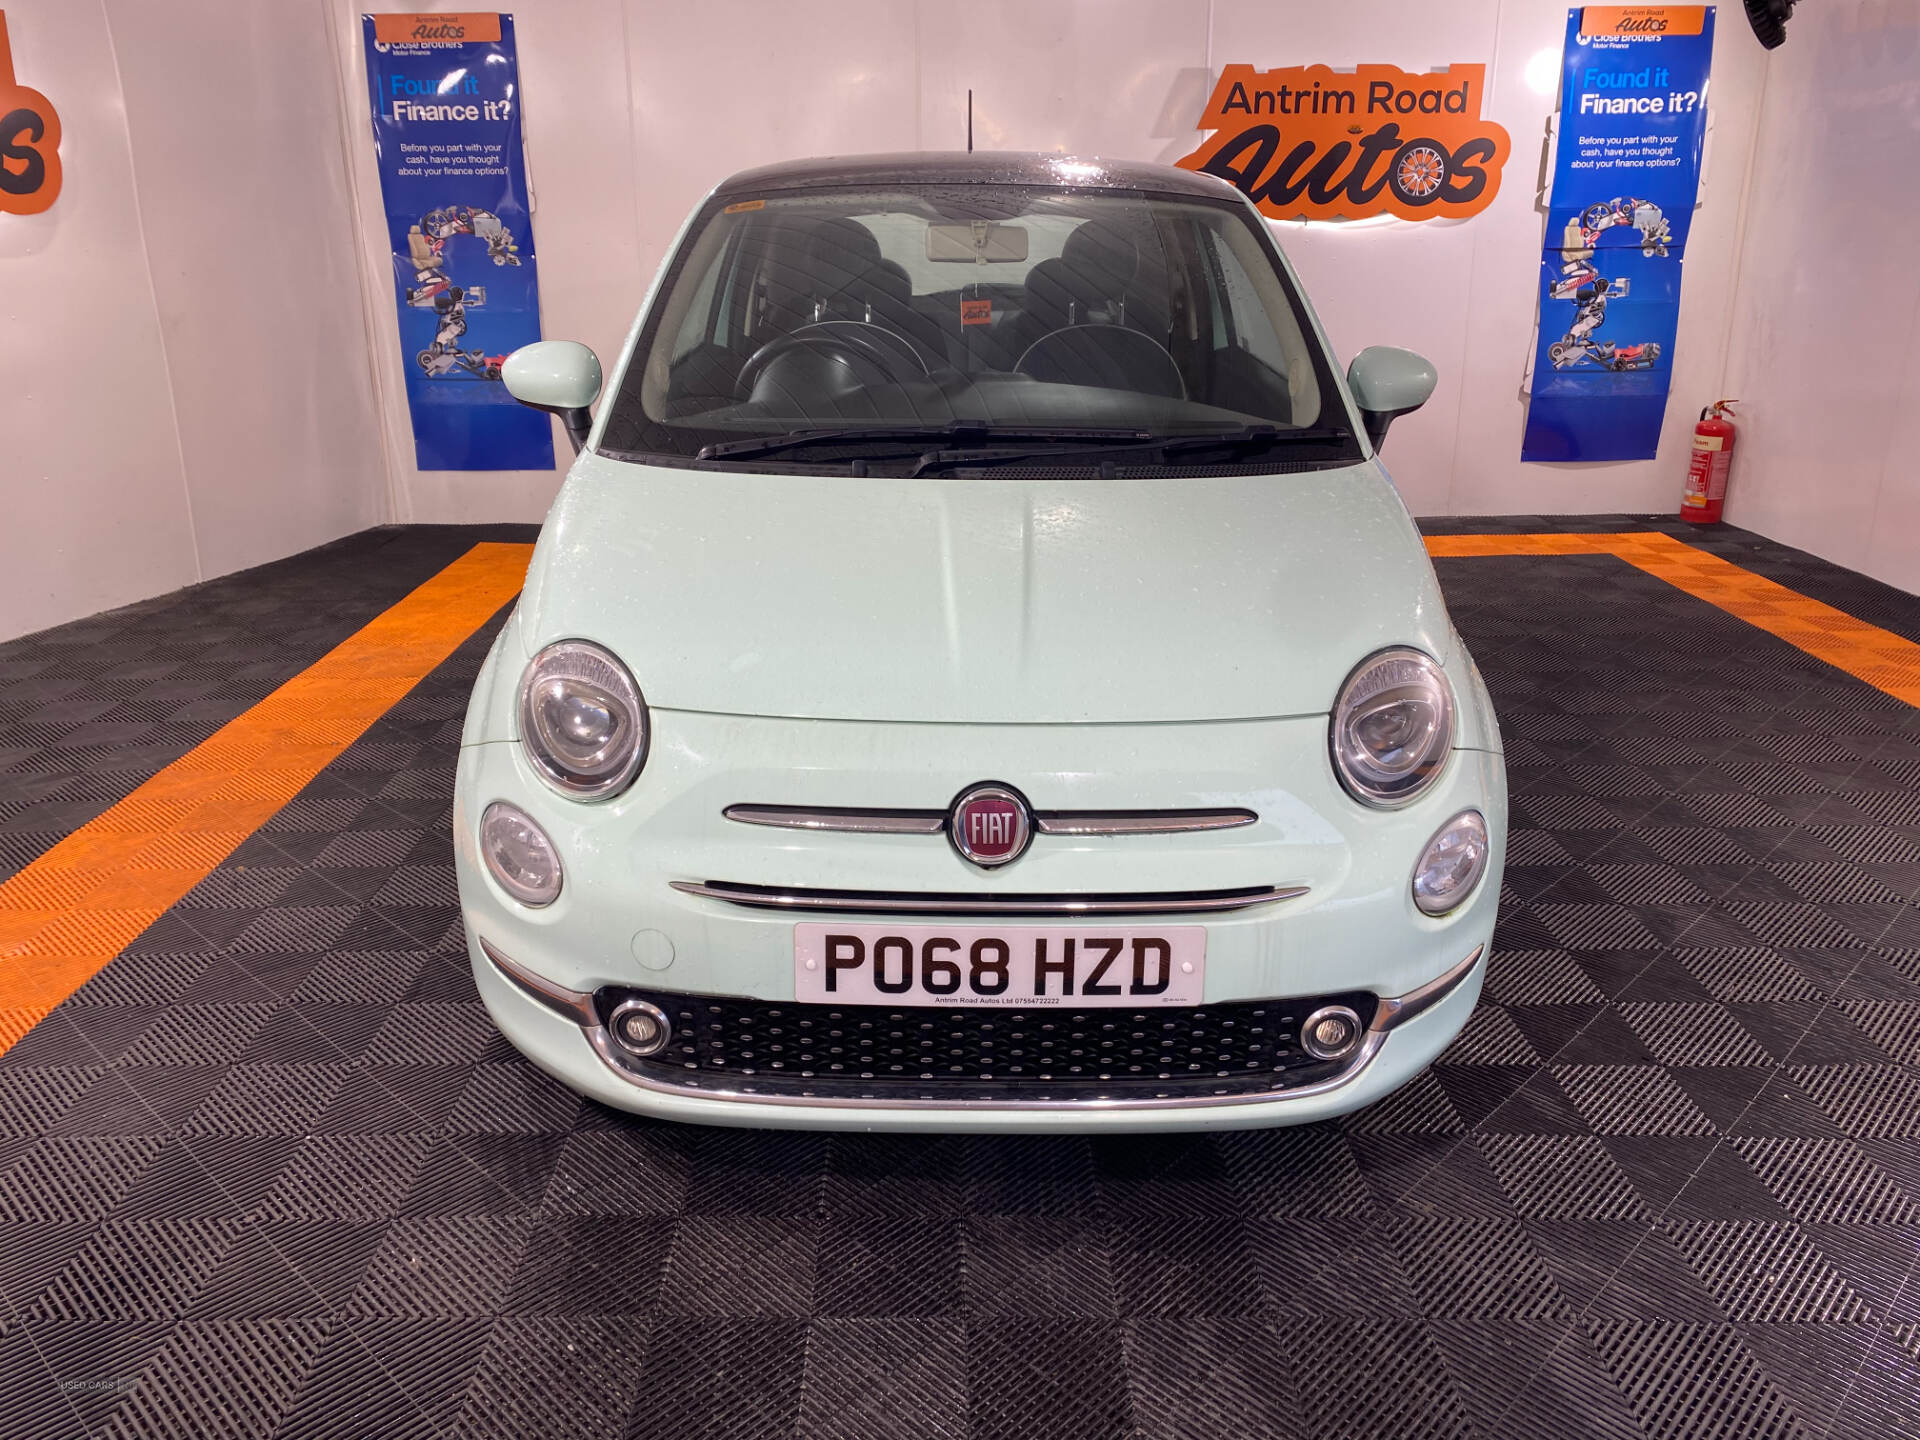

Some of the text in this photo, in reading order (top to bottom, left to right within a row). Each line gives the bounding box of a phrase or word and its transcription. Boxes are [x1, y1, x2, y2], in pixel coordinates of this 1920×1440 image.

[411, 24, 465, 39] Autos
[1616, 17, 1668, 32] Autos
[464, 74, 479, 95] it
[1583, 67, 1670, 89] Found it
[1220, 80, 1470, 115] Antrim Road
[1580, 91, 1698, 114] Finance it?
[392, 100, 511, 121] Finance it?
[1578, 135, 1678, 146] Before you part with your
[400, 143, 502, 154] Before you part with your
[1581, 147, 1673, 157] cash, have you thought
[405, 155, 500, 165] cash, have you thought
[1197, 122, 1497, 207] Autos
[1571, 158, 1681, 169] about your finance options?
[398, 166, 509, 177] about your finance options?
[971, 812, 1013, 845] FIAT
[824, 934, 1172, 997] PO68 HZD
[935, 996, 958, 1004] Antrim
